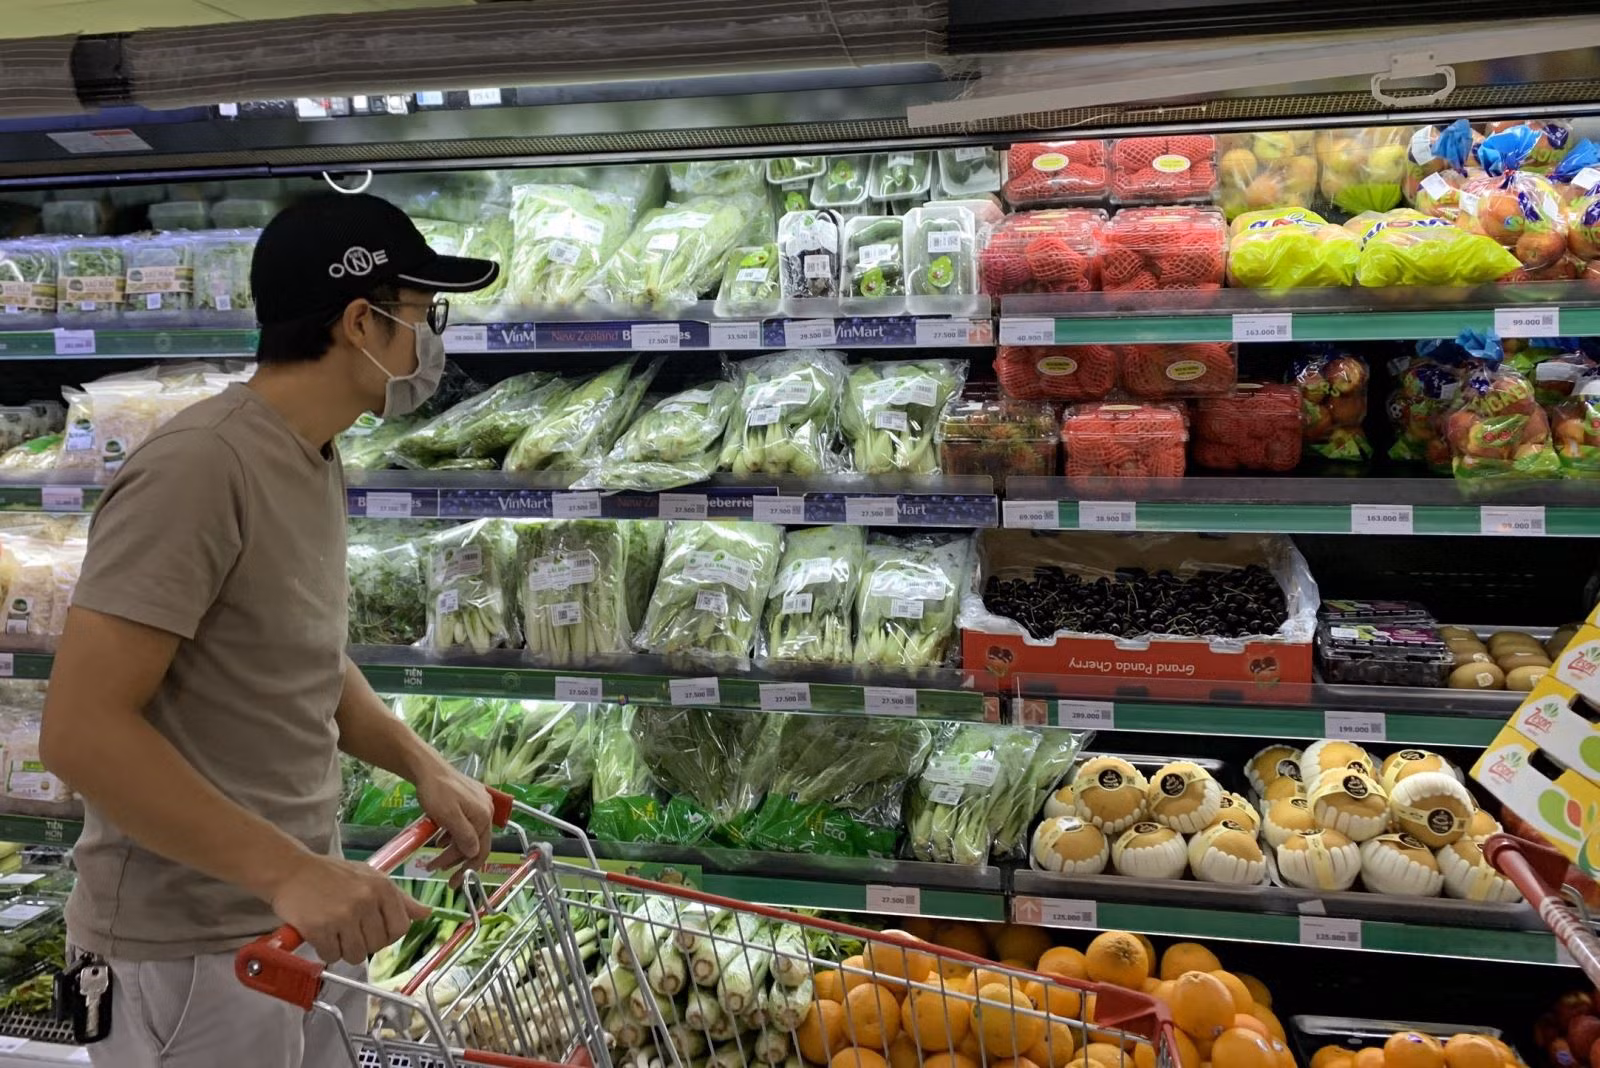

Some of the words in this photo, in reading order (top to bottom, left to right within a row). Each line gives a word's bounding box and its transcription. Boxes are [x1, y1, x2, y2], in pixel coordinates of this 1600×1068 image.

[552, 331, 574, 341] New
[577, 330, 618, 342] Zealand
[498, 496, 549, 511] VinMart
[707, 497, 753, 508] eberrie
[897, 503, 927, 515] Mart
[1069, 657, 1112, 672] Cherry
[1116, 662, 1152, 675] Panda
[1156, 664, 1195, 675] Grand
[1339, 725, 1369, 733] 199.000
